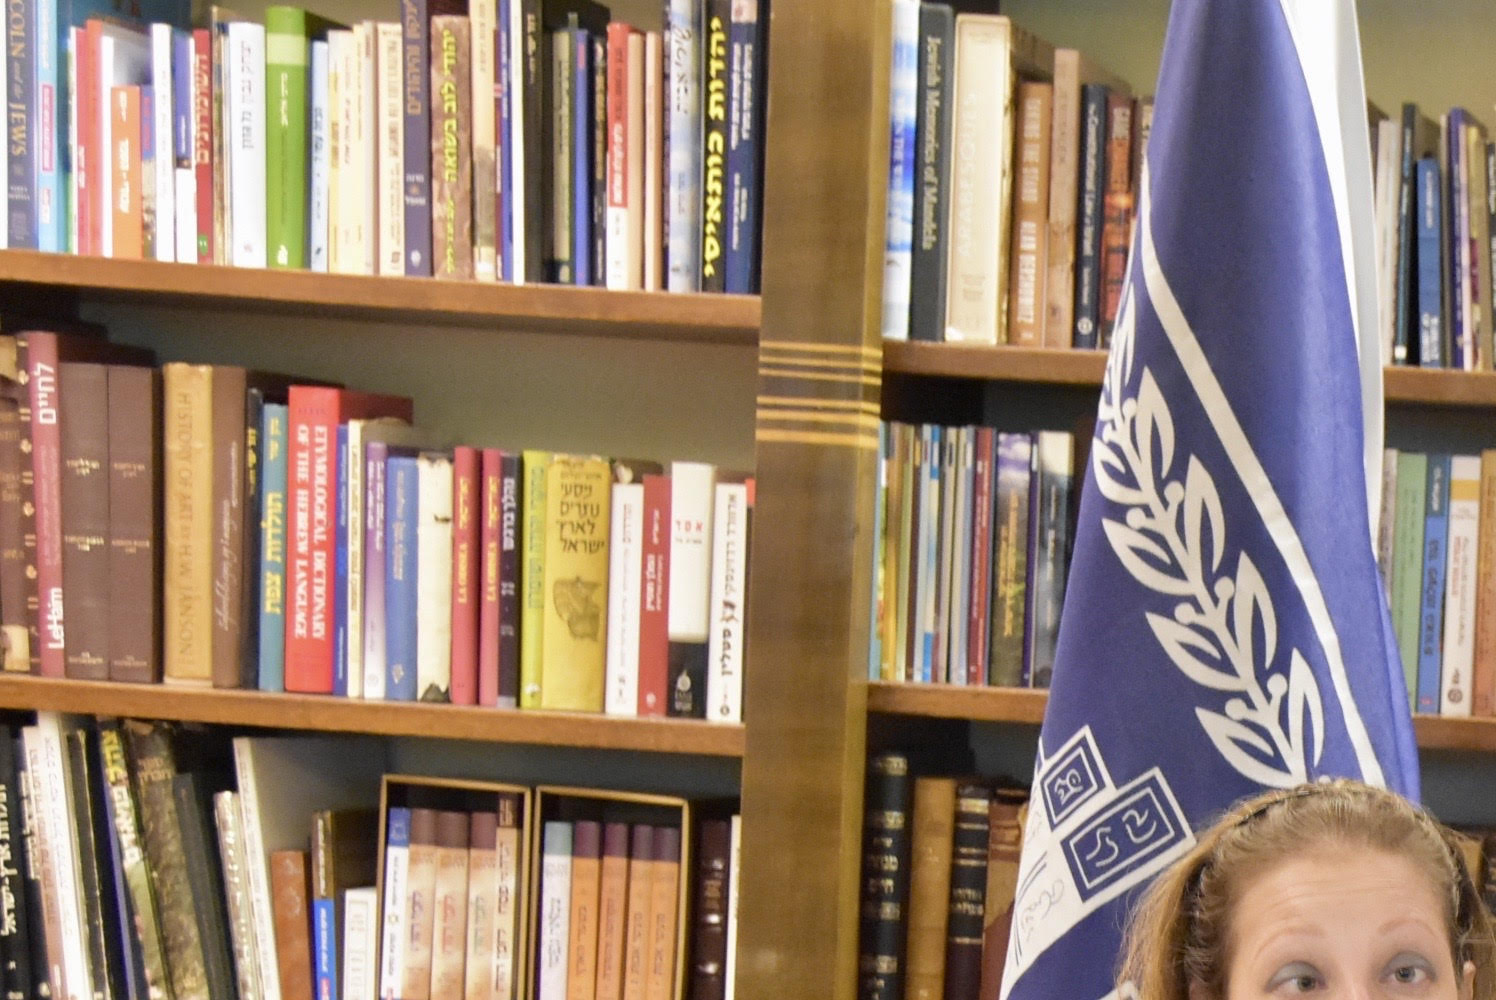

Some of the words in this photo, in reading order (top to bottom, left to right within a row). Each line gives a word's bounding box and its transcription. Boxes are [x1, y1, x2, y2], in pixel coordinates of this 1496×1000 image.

[441, 28, 457, 77] יהודי
[708, 16, 726, 121] יהדות
[927, 36, 941, 87] Jewish
[440, 82, 457, 114] לוב
[8, 102, 27, 156] JEWS
[442, 119, 458, 183] בשואה
[925, 89, 940, 163] Memories
[924, 165, 938, 186] of
[922, 187, 938, 251] Mandela
[36, 362, 57, 425] לחיים
[297, 424, 310, 446] OF
[296, 450, 310, 482] THE
[313, 425, 328, 544] ETYMOLOGICAL
[178, 493, 193, 521] ART
[261, 492, 283, 563] תולדות
[296, 490, 309, 553] HEBREW
[556, 518, 597, 539] לארץ
[560, 538, 606, 555] ישראל
[48, 586, 65, 650] LeHaim
[264, 573, 283, 615] צפת
[294, 558, 309, 640] LANGUAGE
[312, 550, 327, 641] DICTIONARY
[719, 628, 734, 677] סטלין
